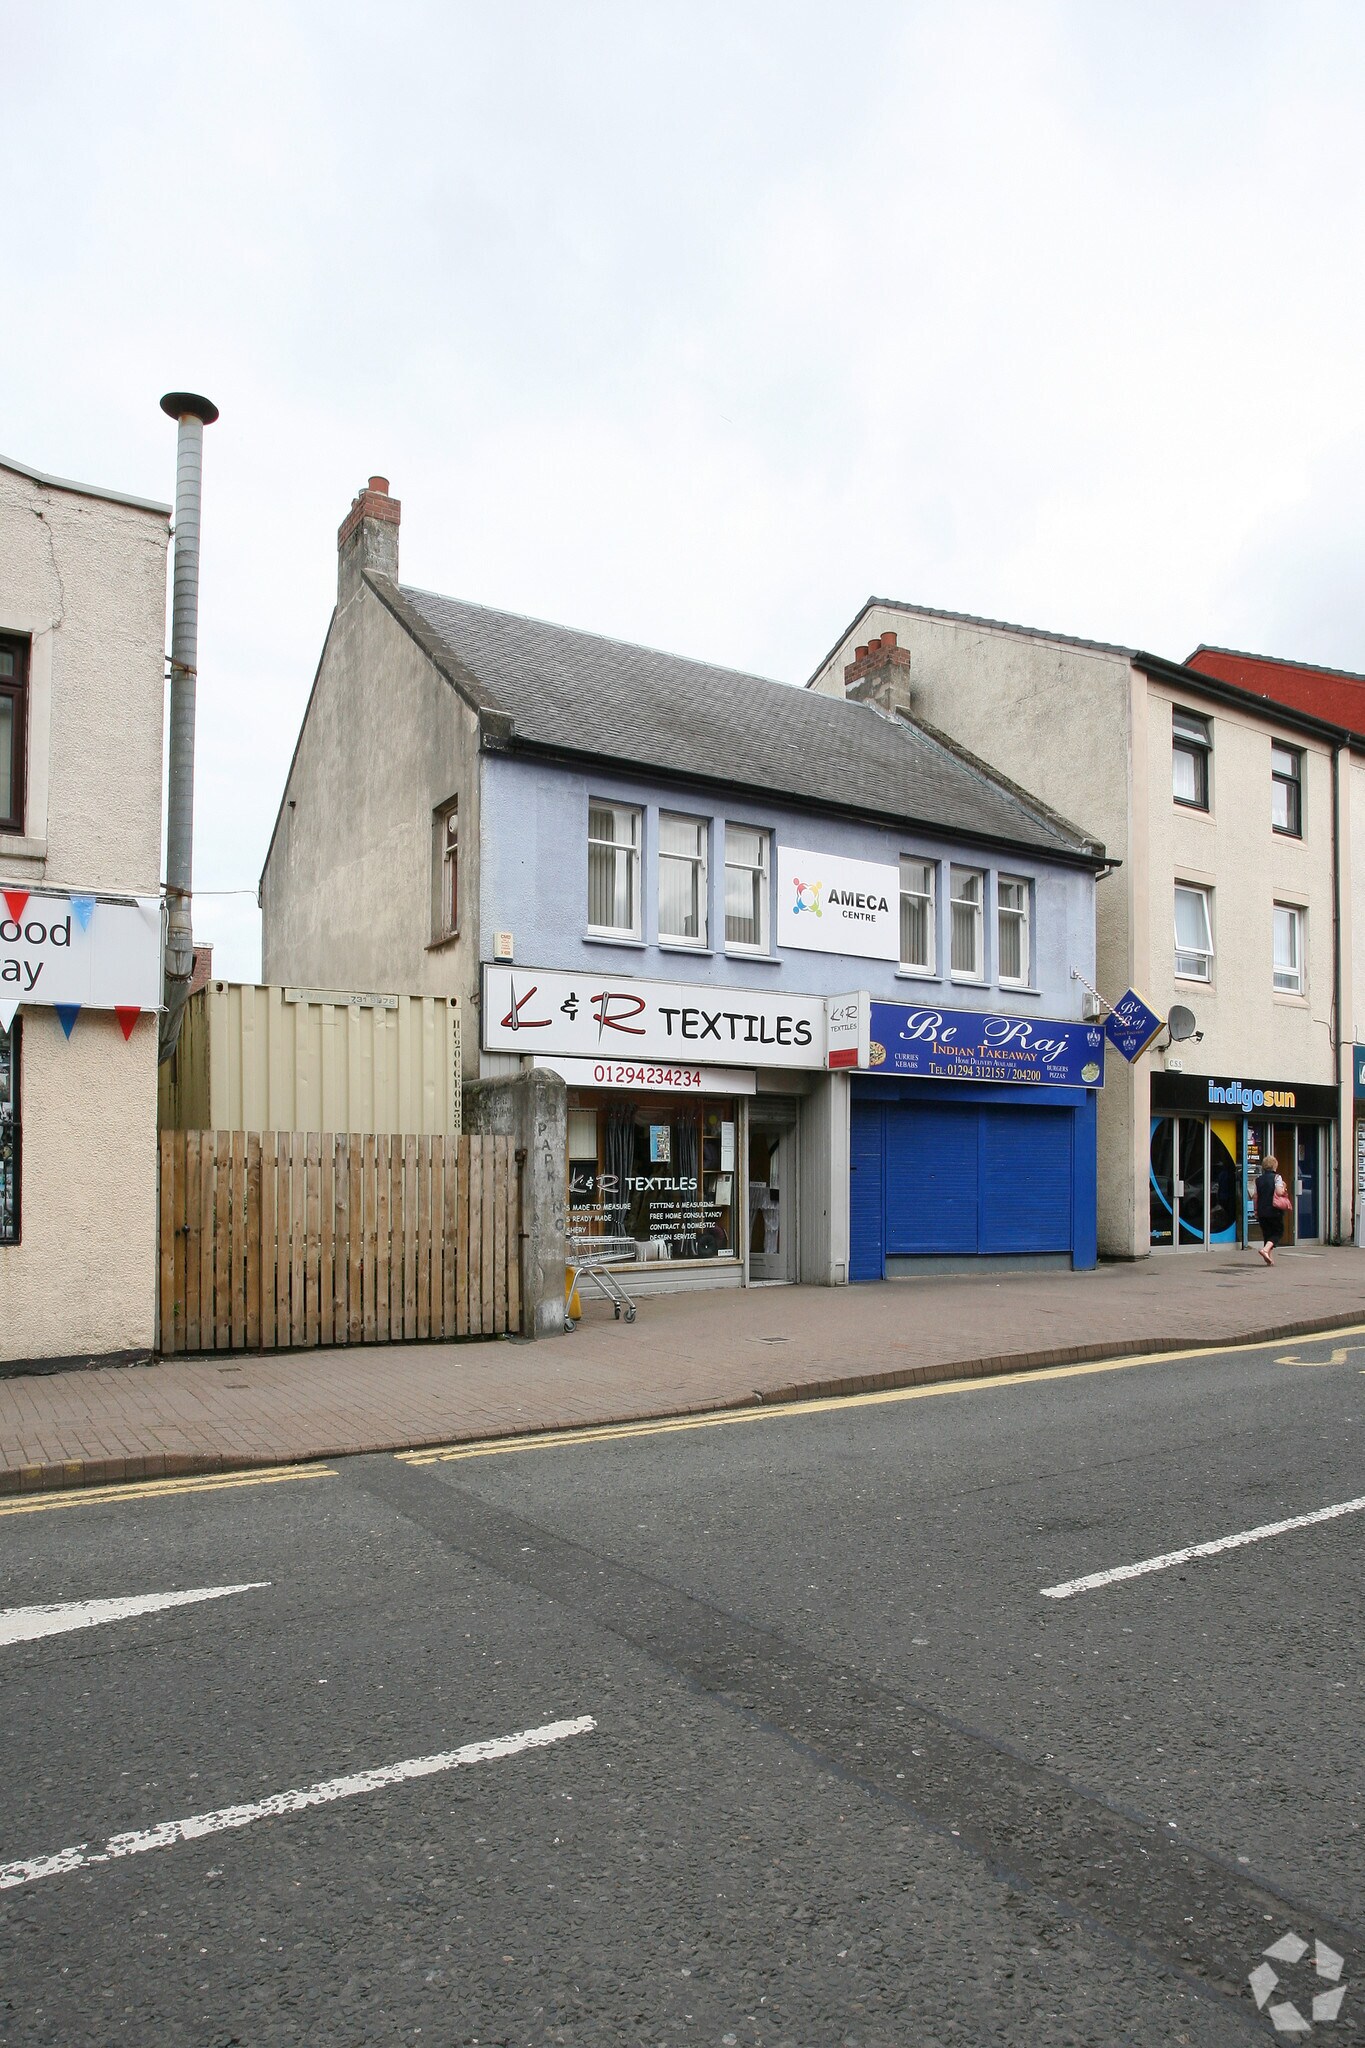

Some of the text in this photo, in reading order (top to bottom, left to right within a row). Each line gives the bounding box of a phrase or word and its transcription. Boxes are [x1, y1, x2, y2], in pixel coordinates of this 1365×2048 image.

[828, 889, 889, 912] AMECA
[842, 910, 876, 922] CENTRE
[1121, 1001, 1141, 1015] Be
[560, 992, 579, 1021] &
[590, 990, 646, 1046] R
[658, 1007, 813, 1045] TEXTILES
[830, 1022, 857, 1033] TEXTILES
[900, 1010, 1068, 1063] Be Raj
[894, 1052, 919, 1061] CURRIES
[932, 1041, 1038, 1062] INDIAN TAKEAWAY
[895, 1060, 918, 1069] KEBABS
[1046, 1064, 1069, 1072] BURGERS
[594, 1064, 702, 1087] 01294234234
[947, 1063, 974, 1077] 01294
[975, 1065, 1005, 1079] 312155
[1006, 1068, 1011, 1079] /
[1012, 1068, 1041, 1081] 204200
[1208, 1080, 1296, 1112] indigosun
[625, 1176, 698, 1191] TEXTILES
[594, 1214, 612, 1222] MADE
[649, 1212, 664, 1220] FREE
[683, 1211, 722, 1219] CONSULTANCY
[687, 1221, 716, 1229] DOMESTIC
[673, 1232, 697, 1240] SERVICE
